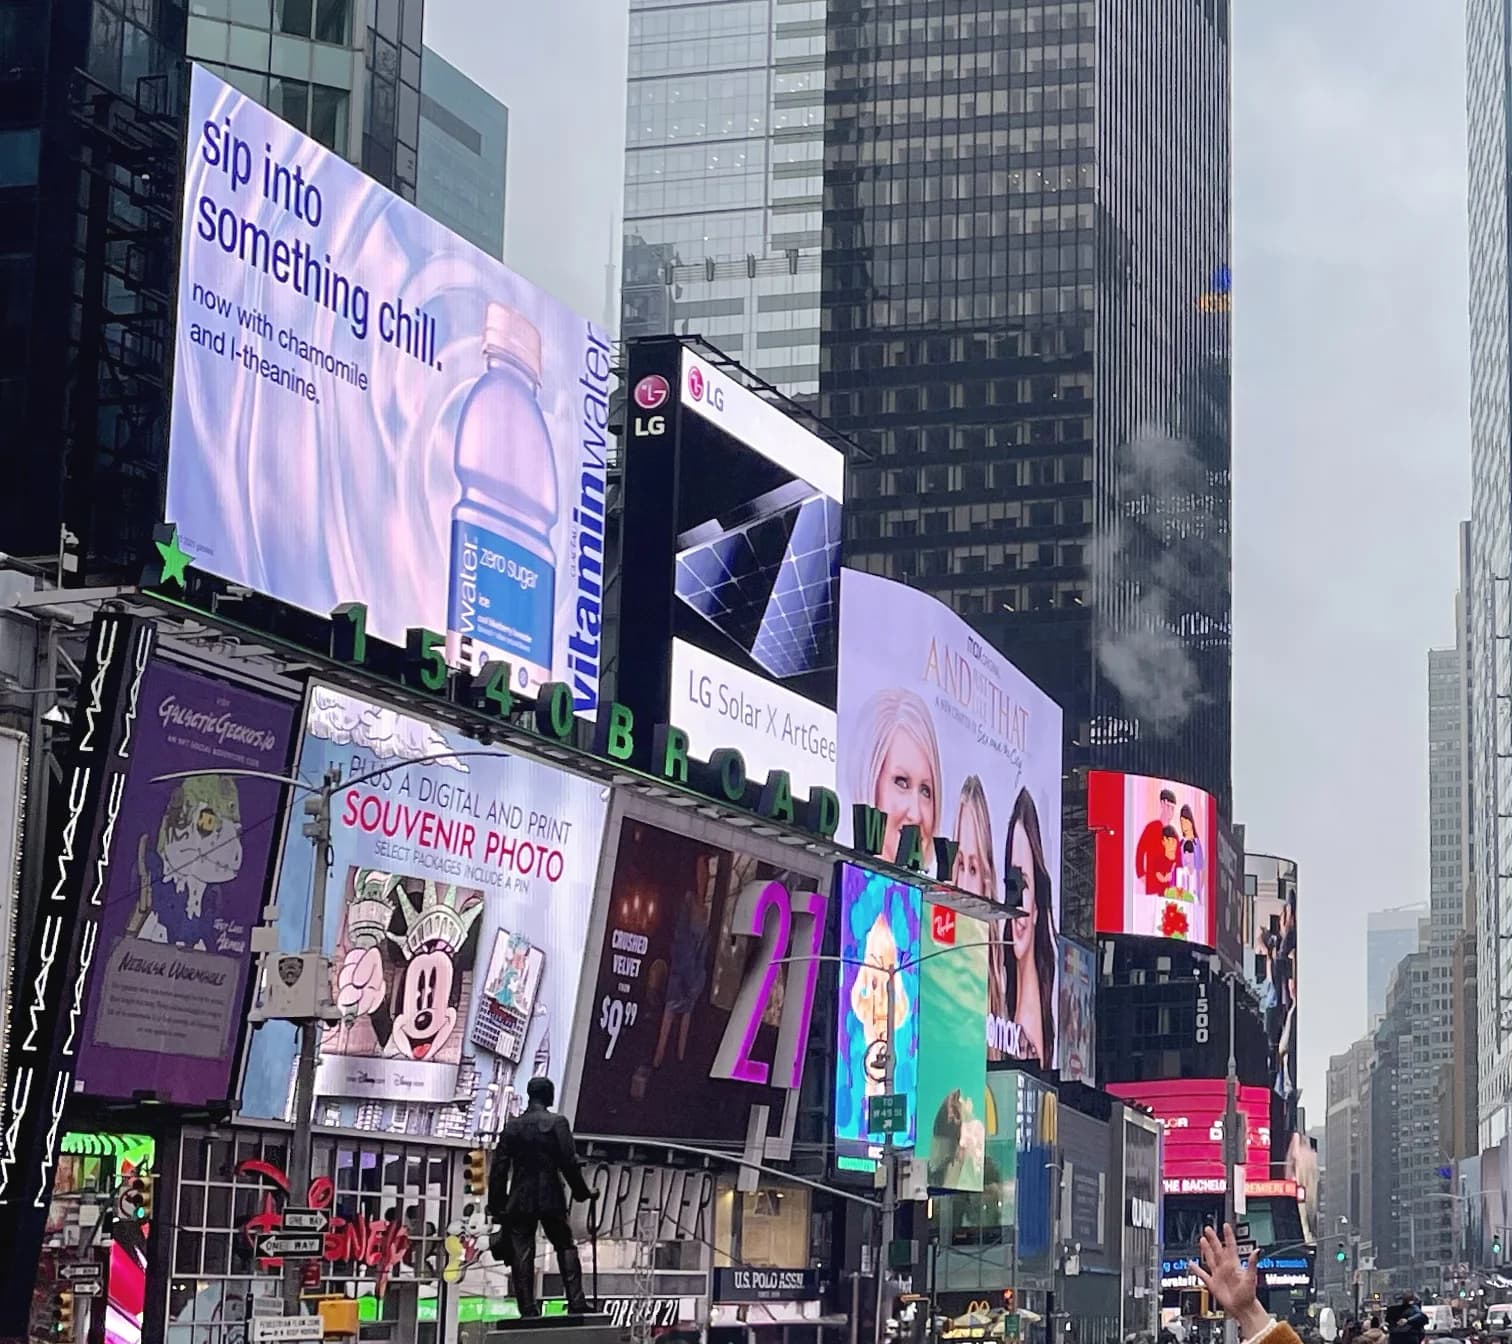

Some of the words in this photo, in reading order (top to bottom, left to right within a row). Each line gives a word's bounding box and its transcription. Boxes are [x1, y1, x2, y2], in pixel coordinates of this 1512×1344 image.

[202, 117, 251, 192] sip
[264, 142, 322, 228] into
[198, 196, 369, 340] something
[379, 298, 442, 371] chill.
[190, 323, 225, 355] and
[192, 282, 232, 318] now
[237, 308, 273, 341] with
[278, 328, 368, 391] chamomile
[635, 415, 665, 436] LG
[705, 383, 725, 412] LG
[480, 548, 506, 573] zero
[507, 560, 538, 590] sugar
[689, 669, 711, 710] LG
[719, 683, 761, 730] Solar
[766, 704, 778, 736] X
[988, 681, 1029, 753] THAT
[349, 755, 393, 794] PLUS
[398, 776, 411, 797] A
[418, 776, 480, 819] DIGITAL
[486, 800, 523, 830] AND
[529, 809, 573, 846] PRINT
[342, 790, 475, 858] SOUVENIR
[484, 831, 564, 883] PHOTO
[374, 839, 409, 864] SELECT
[412, 847, 461, 878] PACKAGES
[513, 876, 529, 894] PIN
[612, 929, 648, 955] CRUSHED
[613, 954, 641, 978] VELVET
[712, 880, 828, 1089] 21
[1196, 983, 1209, 1043] 1500
[568, 1164, 713, 1241] OREVER
[1182, 1178, 1226, 1193] BACHELO
[266, 1240, 289, 1251] ONE
[294, 1240, 315, 1249] WAY
[735, 1271, 751, 1289] U.S.
[752, 1272, 777, 1289] POLO
